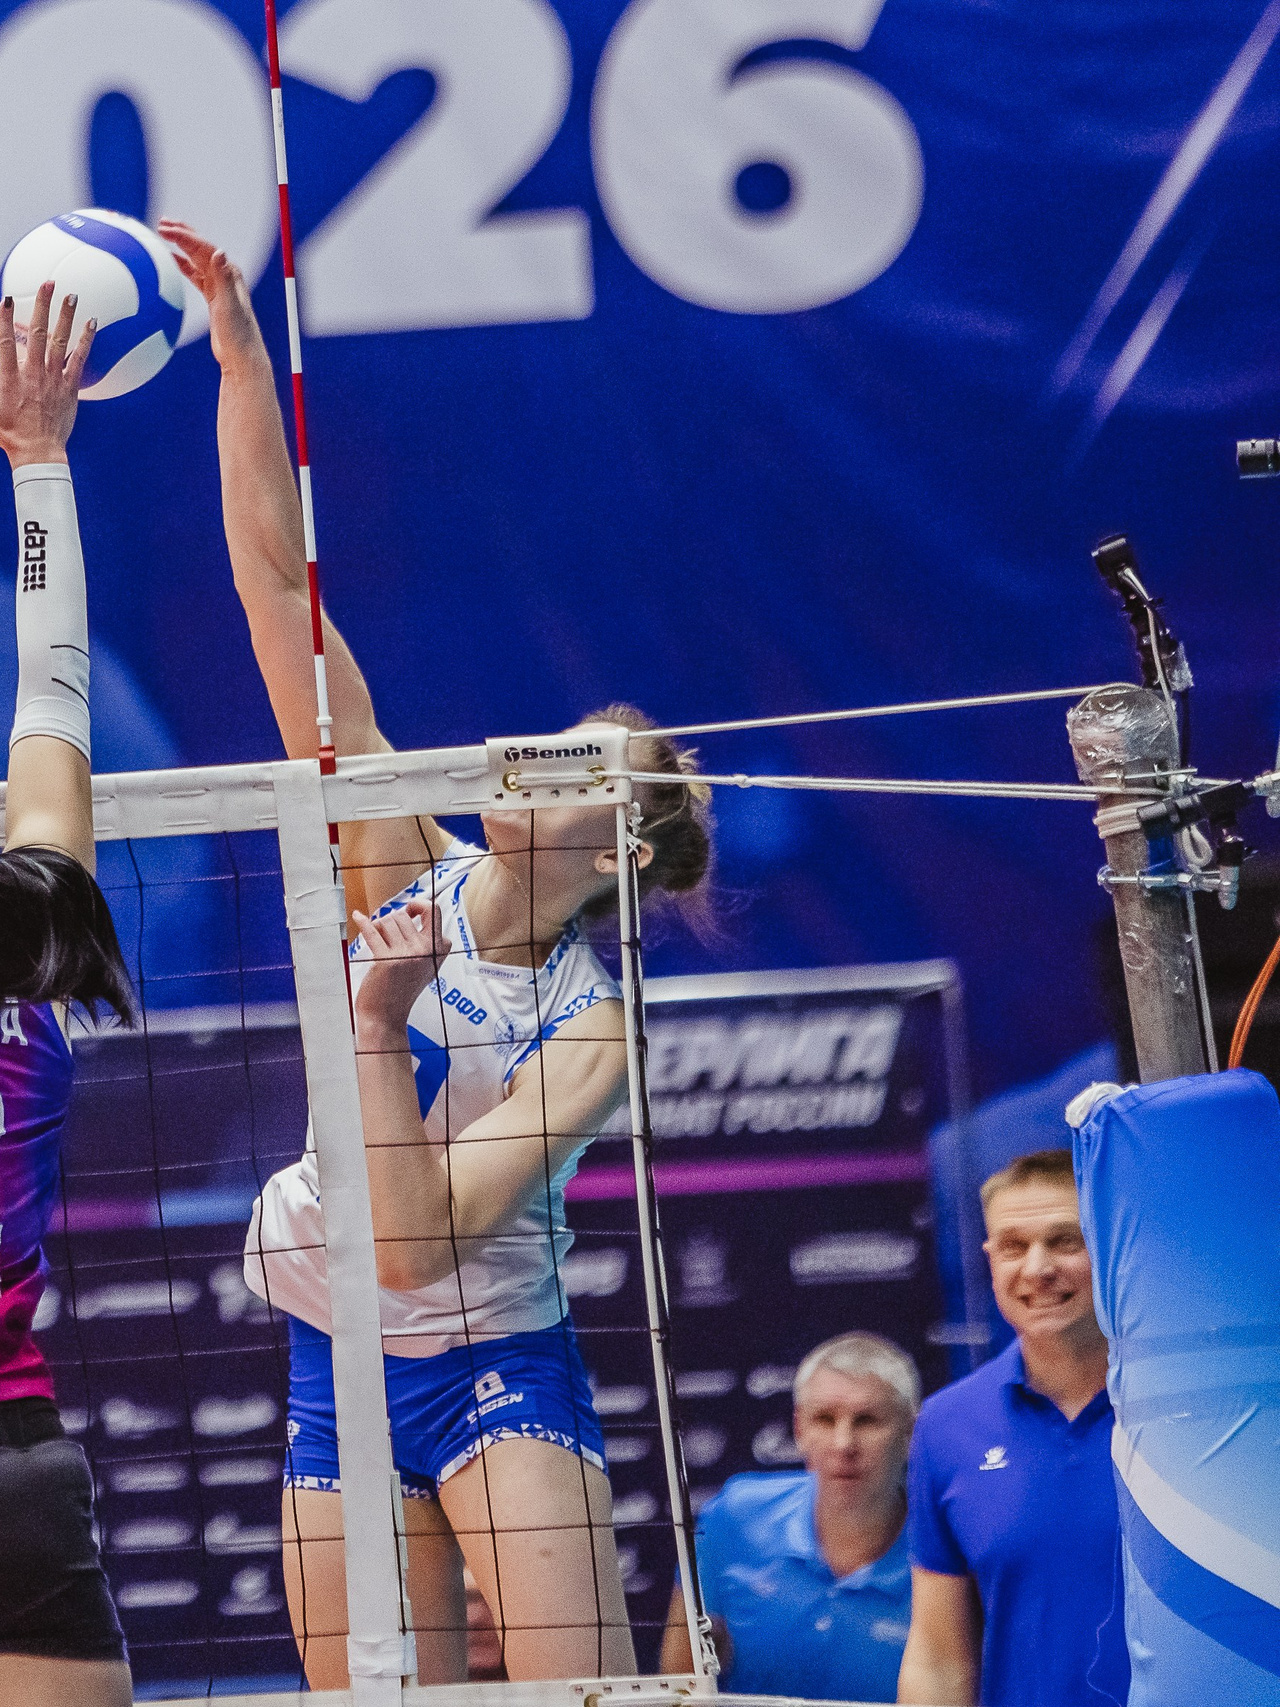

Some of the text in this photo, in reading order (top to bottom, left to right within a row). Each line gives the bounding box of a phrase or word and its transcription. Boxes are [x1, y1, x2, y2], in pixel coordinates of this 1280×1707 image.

[23, 520, 49, 563] cep
[521, 743, 602, 760] Senoh
[442, 987, 488, 1026] ВФВ
